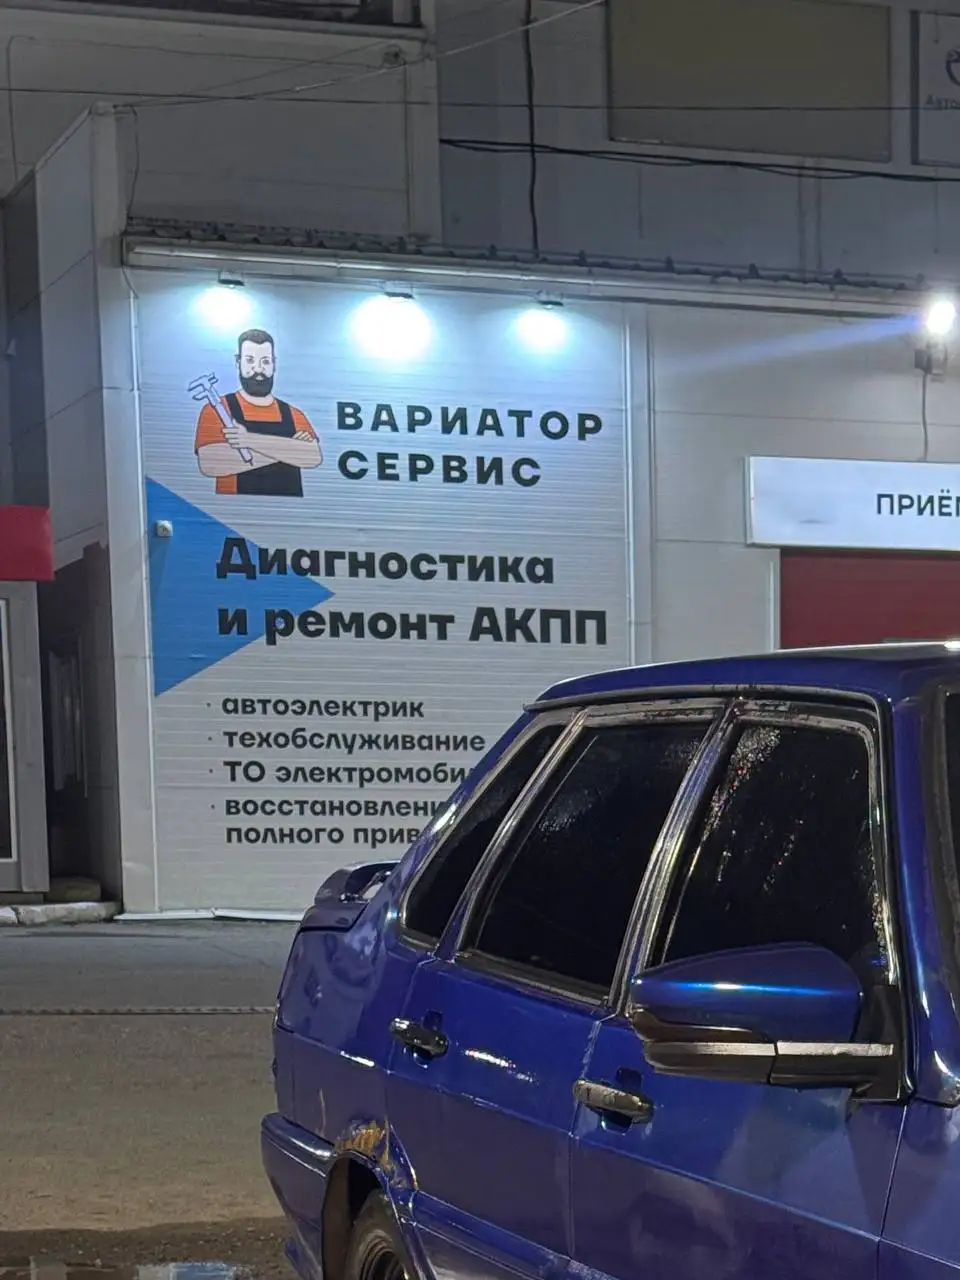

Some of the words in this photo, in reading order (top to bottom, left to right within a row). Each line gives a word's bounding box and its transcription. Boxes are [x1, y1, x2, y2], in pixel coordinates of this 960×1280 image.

[336, 401, 604, 441] ВАРИАТОР
[338, 449, 541, 487] СЕРВИС
[216, 536, 554, 583] Диагностика
[218, 607, 247, 635] и
[264, 608, 454, 645] ремонт
[468, 606, 607, 645] АКПП
[221, 697, 424, 722] автоэлектрик
[222, 727, 486, 755] техобслуживание
[223, 760, 266, 783] ТО
[225, 799, 447, 818] восстановлени
[226, 825, 344, 845] полного
[353, 825, 422, 849] прив
